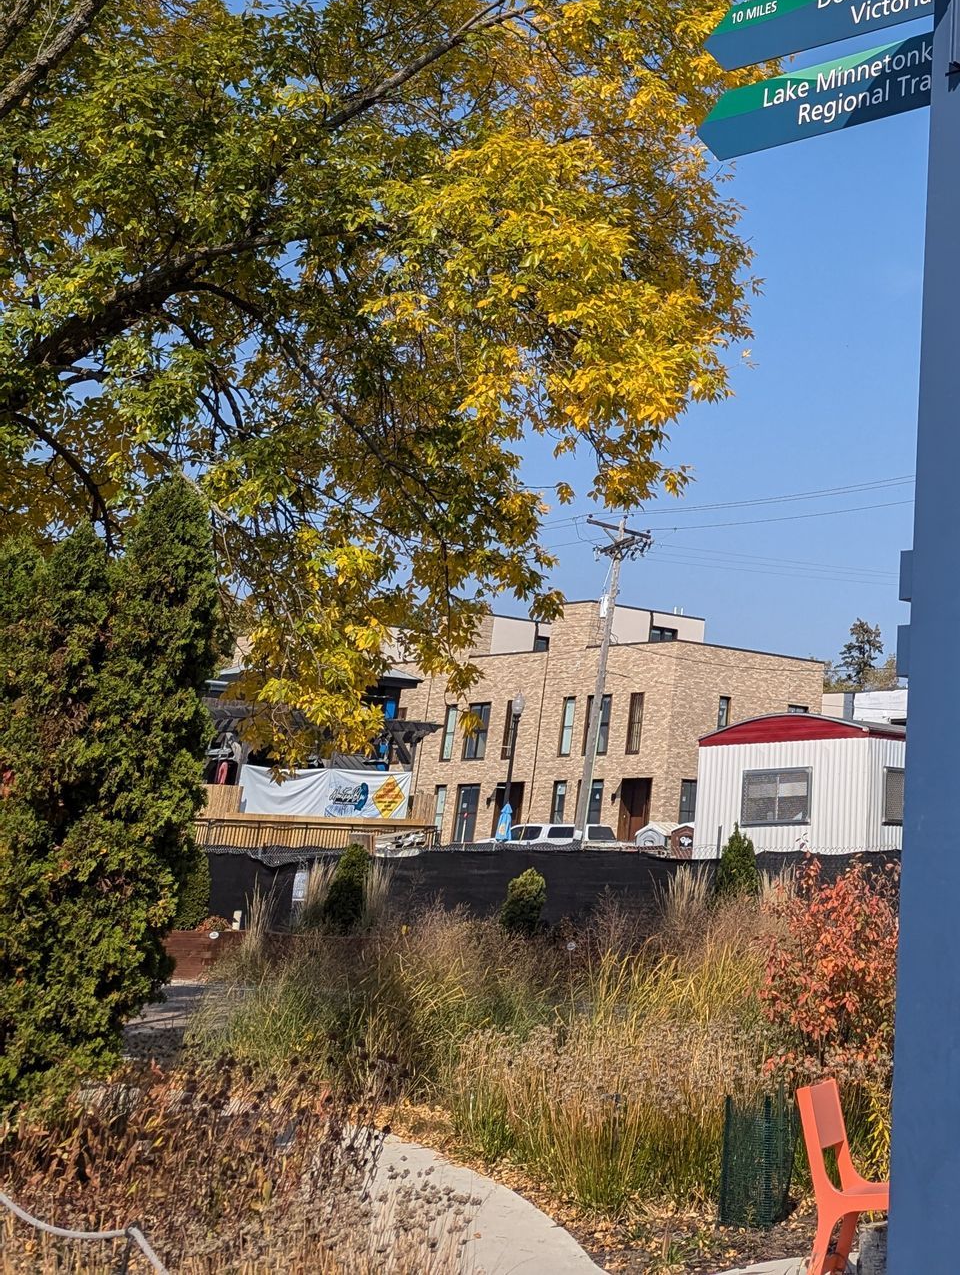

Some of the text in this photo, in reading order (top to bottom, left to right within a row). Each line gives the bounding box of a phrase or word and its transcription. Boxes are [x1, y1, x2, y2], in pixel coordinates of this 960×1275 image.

[731, 1, 777, 24] 10 MILES
[762, 41, 933, 108] Lake Minnetonk
[798, 74, 931, 125] Regional Tra
